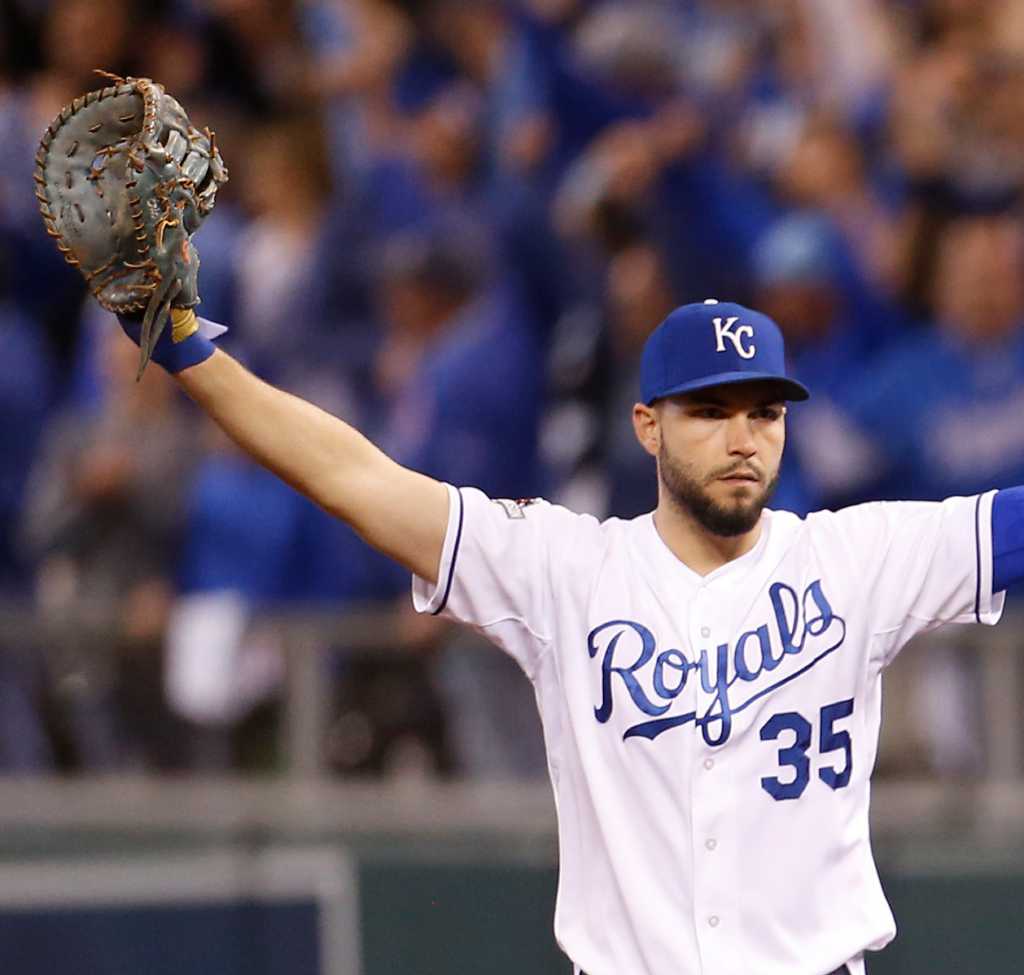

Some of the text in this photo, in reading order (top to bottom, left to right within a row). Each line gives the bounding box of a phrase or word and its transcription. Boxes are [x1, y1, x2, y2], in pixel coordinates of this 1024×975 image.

[712, 316, 756, 359] KC
[587, 579, 846, 747] Royals
[760, 698, 855, 802] 35
